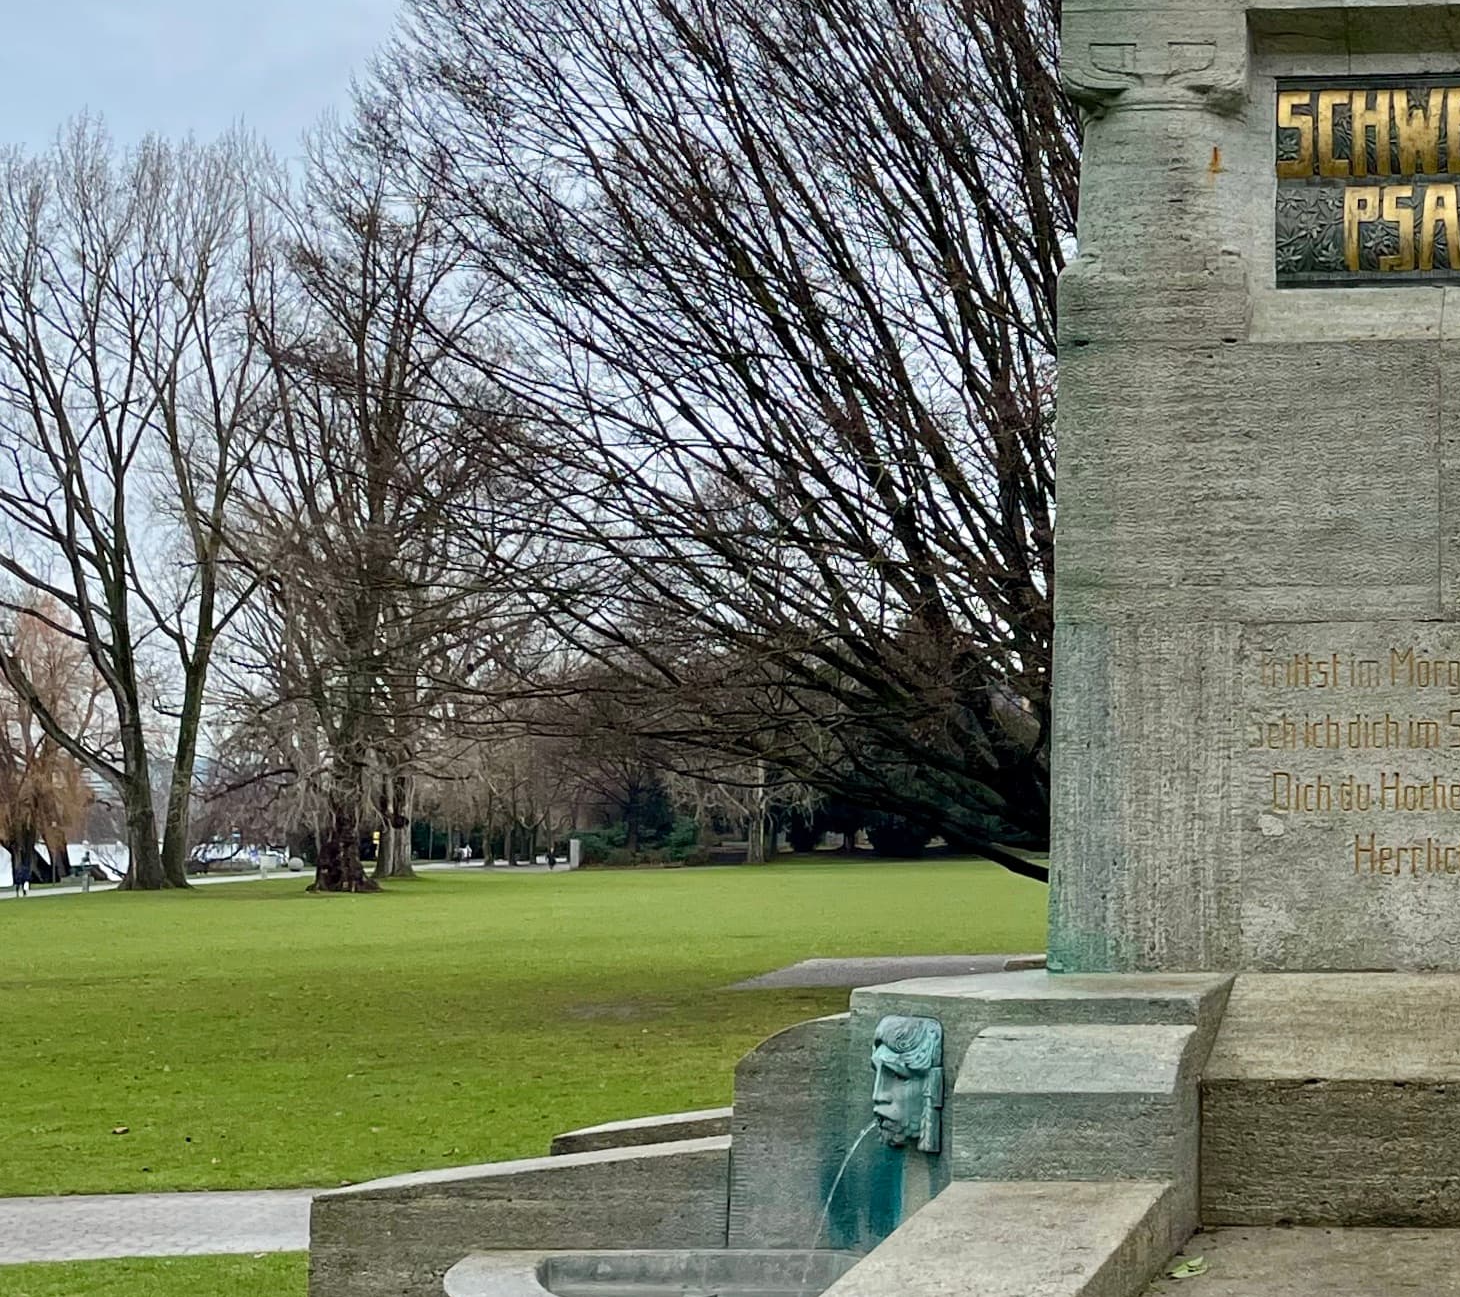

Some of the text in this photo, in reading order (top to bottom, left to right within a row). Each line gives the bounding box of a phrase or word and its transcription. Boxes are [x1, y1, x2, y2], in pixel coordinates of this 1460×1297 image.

[1350, 652, 1380, 688] im
[1304, 713, 1339, 748] ich
[1349, 713, 1399, 748] dich
[1408, 713, 1439, 748] im
[1272, 772, 1331, 812] Dich
[1341, 774, 1370, 812] du
